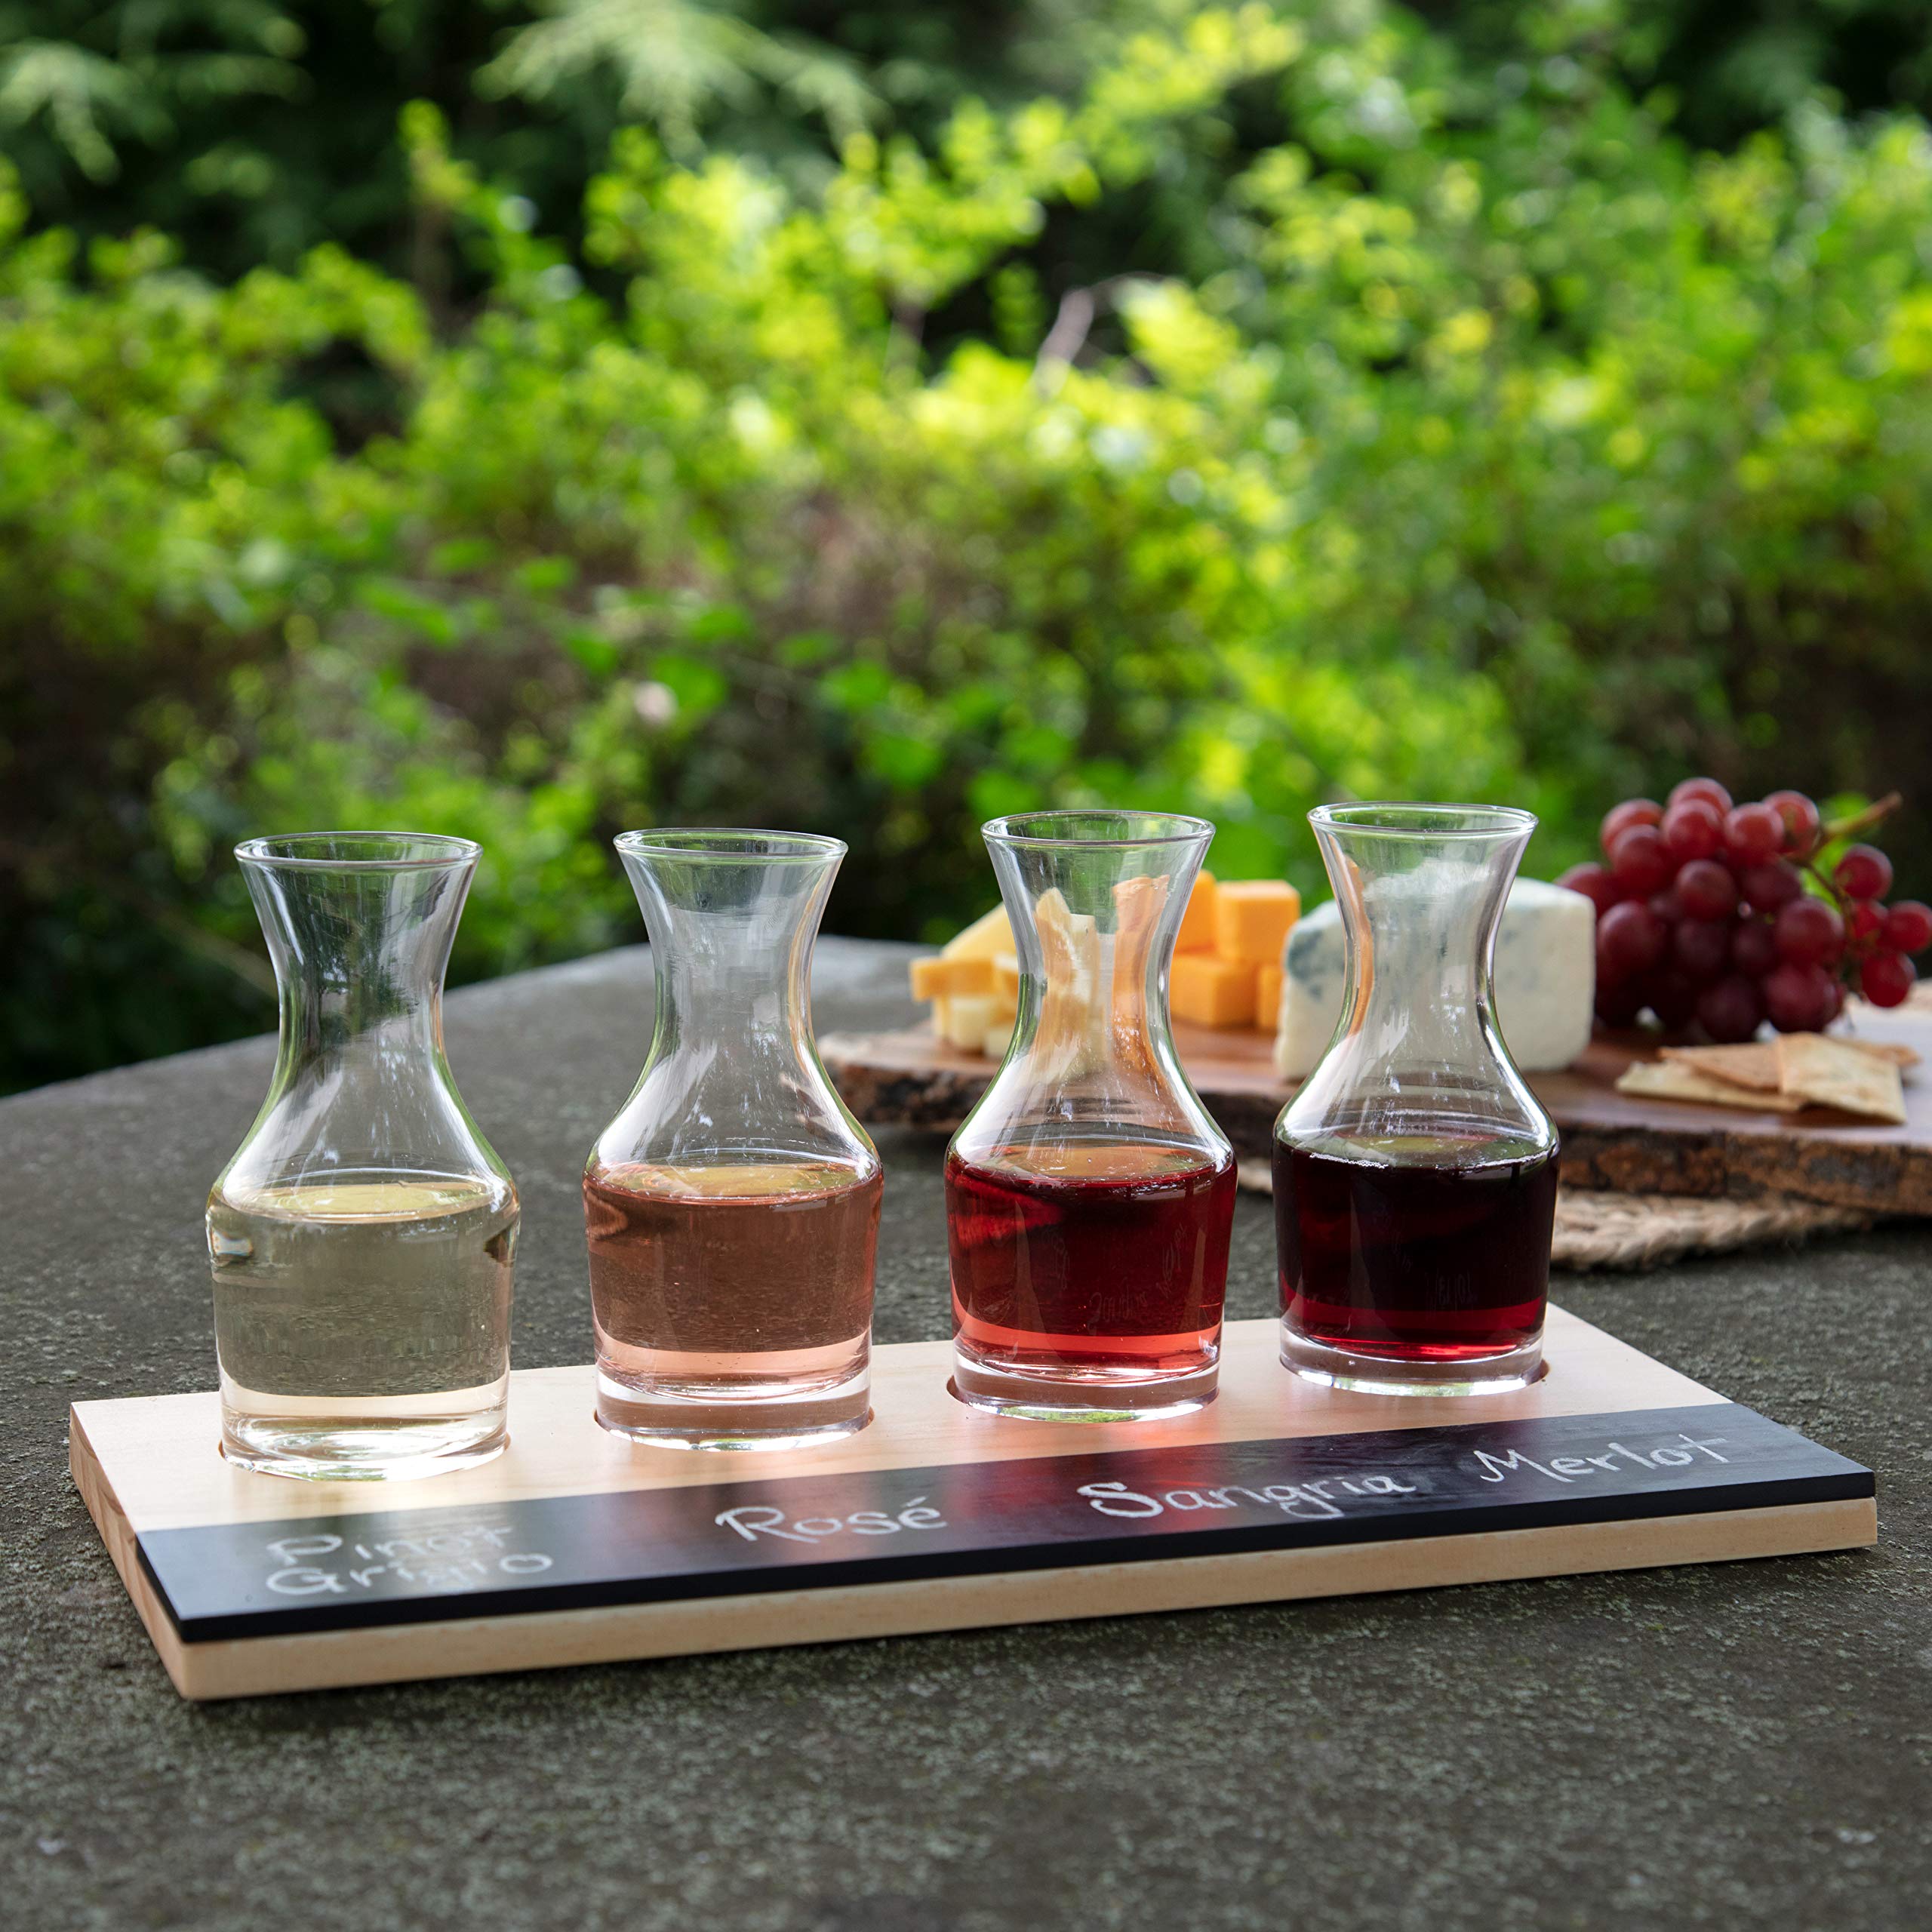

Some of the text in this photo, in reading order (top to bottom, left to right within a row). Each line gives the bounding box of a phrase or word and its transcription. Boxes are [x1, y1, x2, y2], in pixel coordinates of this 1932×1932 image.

[1473, 1433, 1730, 1483] Merlot
[1076, 1475, 1417, 1518] Sangria
[715, 1497, 948, 1543] Rosé
[266, 1525, 513, 1566] Pinot
